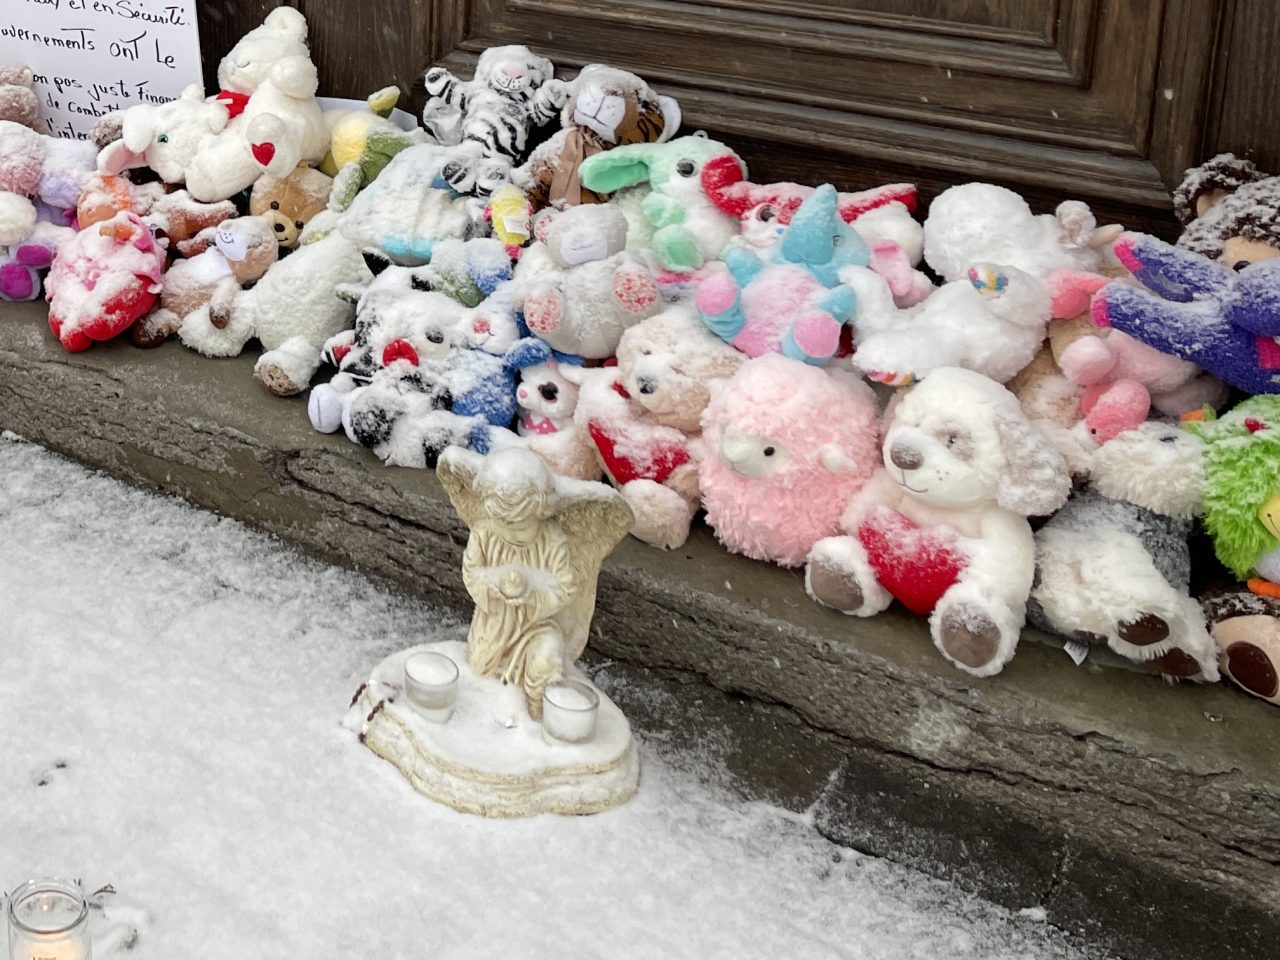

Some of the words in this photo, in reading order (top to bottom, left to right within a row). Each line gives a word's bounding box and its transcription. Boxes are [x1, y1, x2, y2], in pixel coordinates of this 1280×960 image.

[93, 1, 115, 15] en
[155, 38, 176, 68] Le
[54, 76, 83, 94] pas
[46, 93, 61, 109] de
